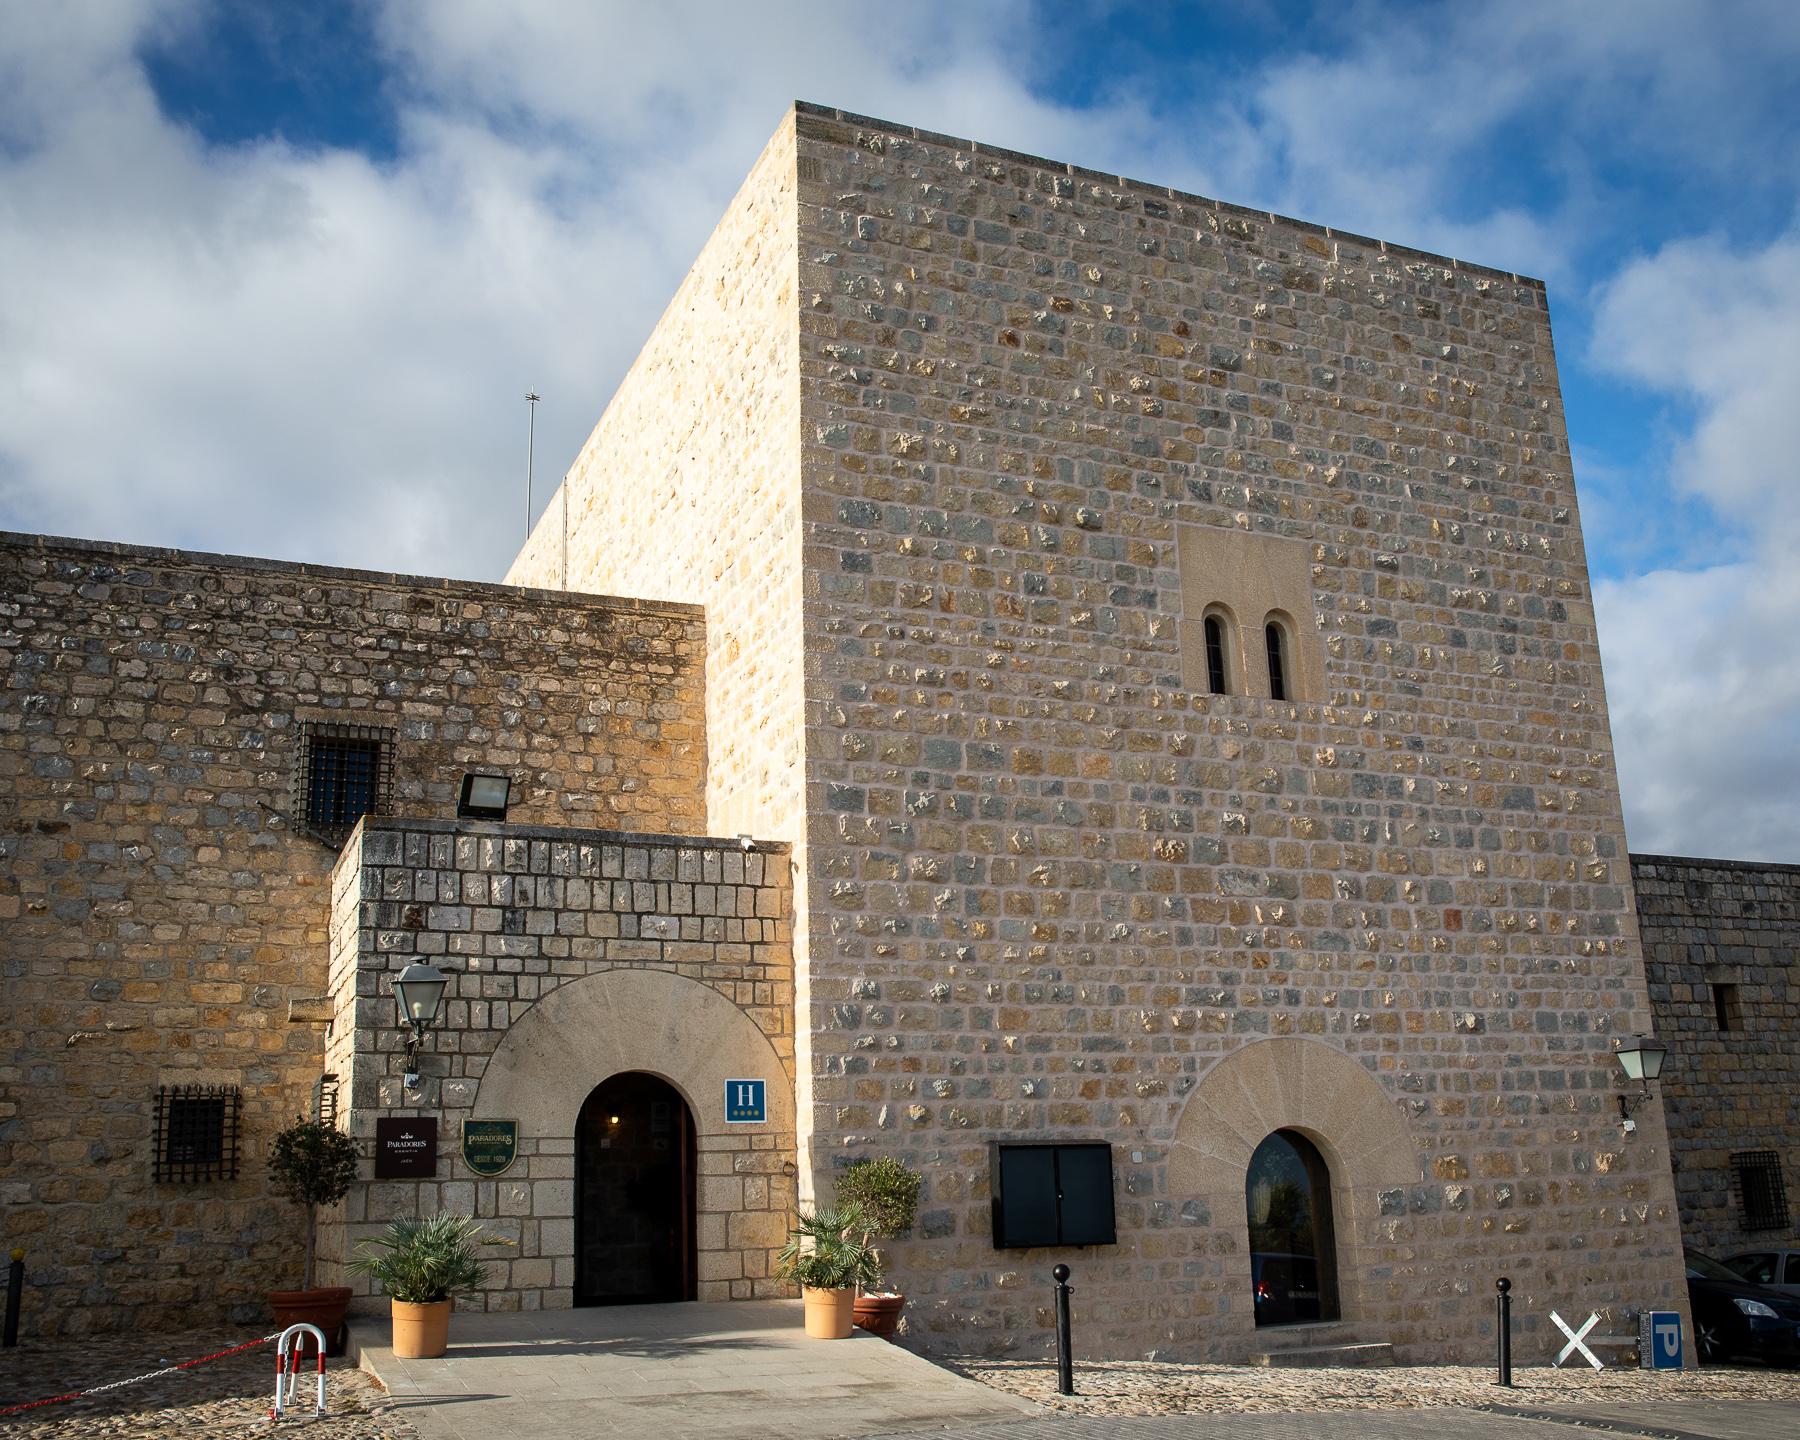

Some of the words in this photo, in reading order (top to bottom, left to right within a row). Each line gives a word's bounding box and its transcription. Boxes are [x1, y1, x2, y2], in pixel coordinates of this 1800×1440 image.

[736, 1084, 755, 1107] H
[387, 1140, 427, 1148] PARADORES
[468, 1134, 513, 1145] PARADORES
[1656, 1325, 1678, 1357] P
